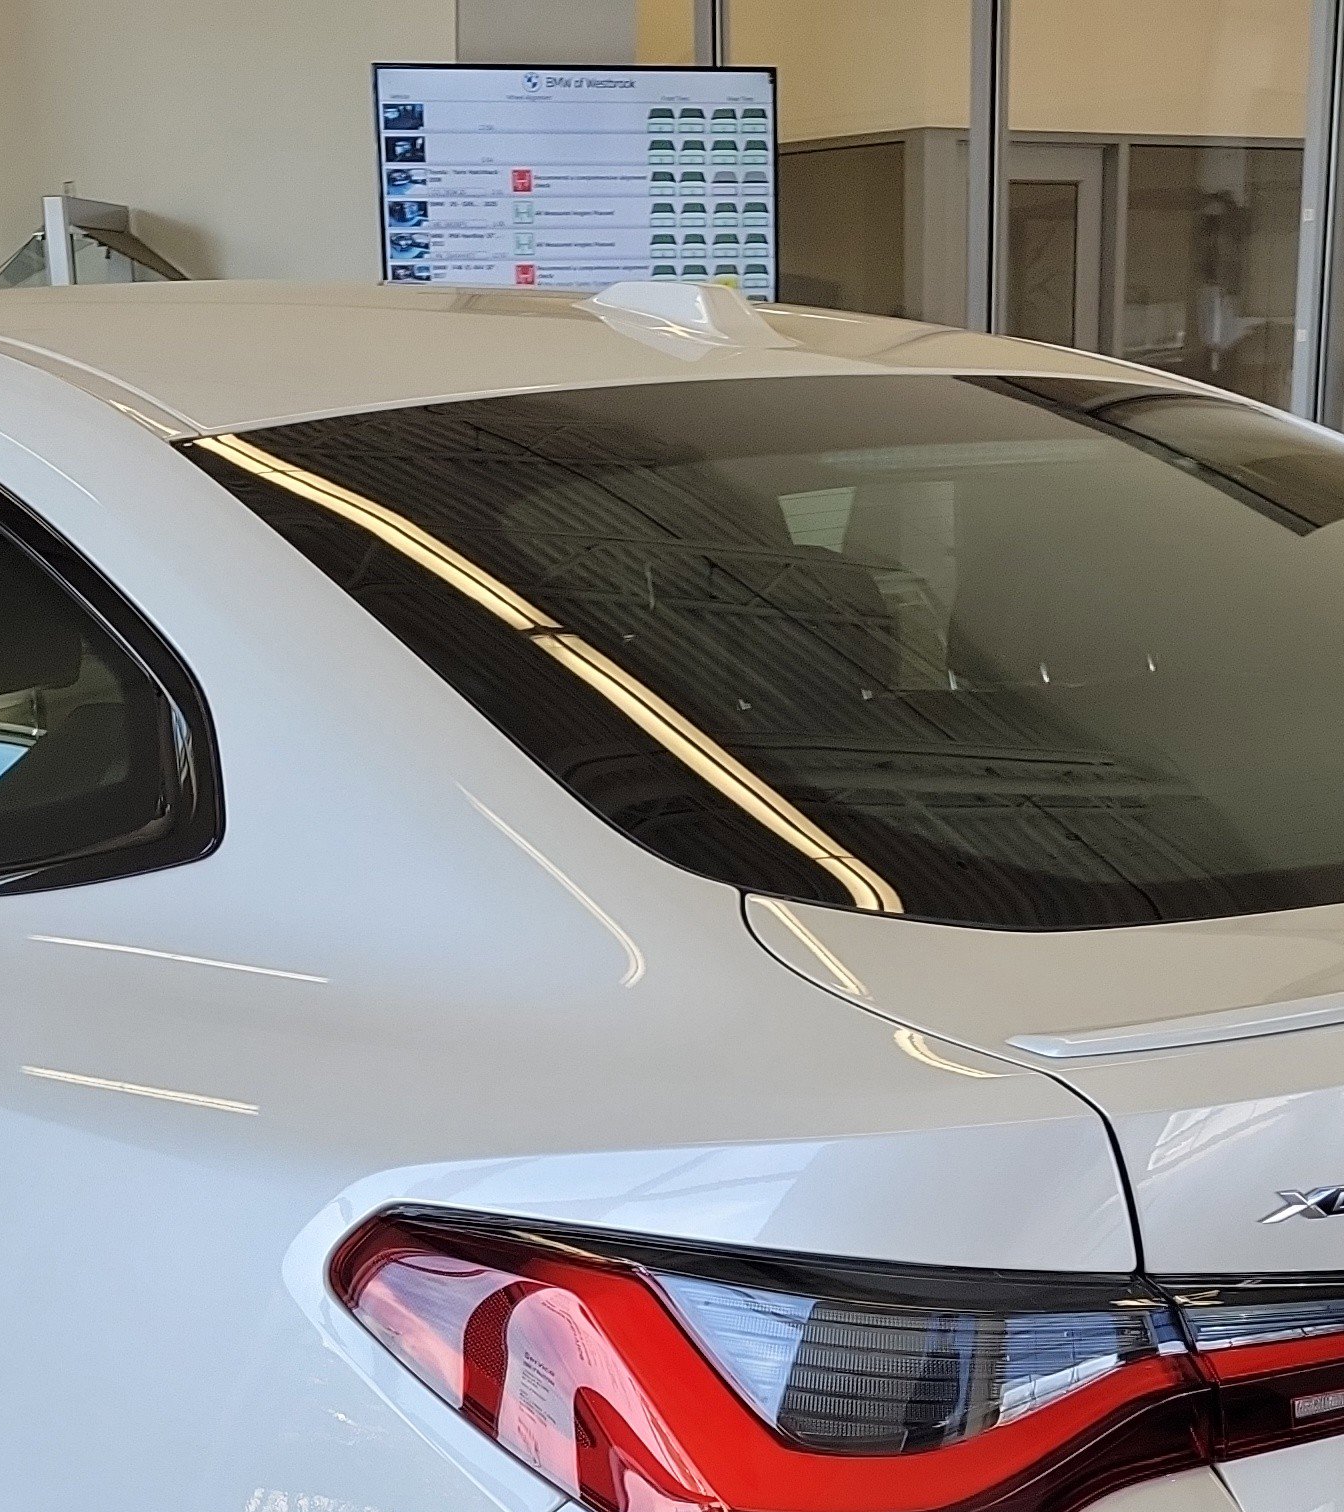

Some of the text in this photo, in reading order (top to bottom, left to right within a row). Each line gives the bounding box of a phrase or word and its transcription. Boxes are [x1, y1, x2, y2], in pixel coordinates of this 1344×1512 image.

[545, 76, 636, 89] BMW of Westbrook
